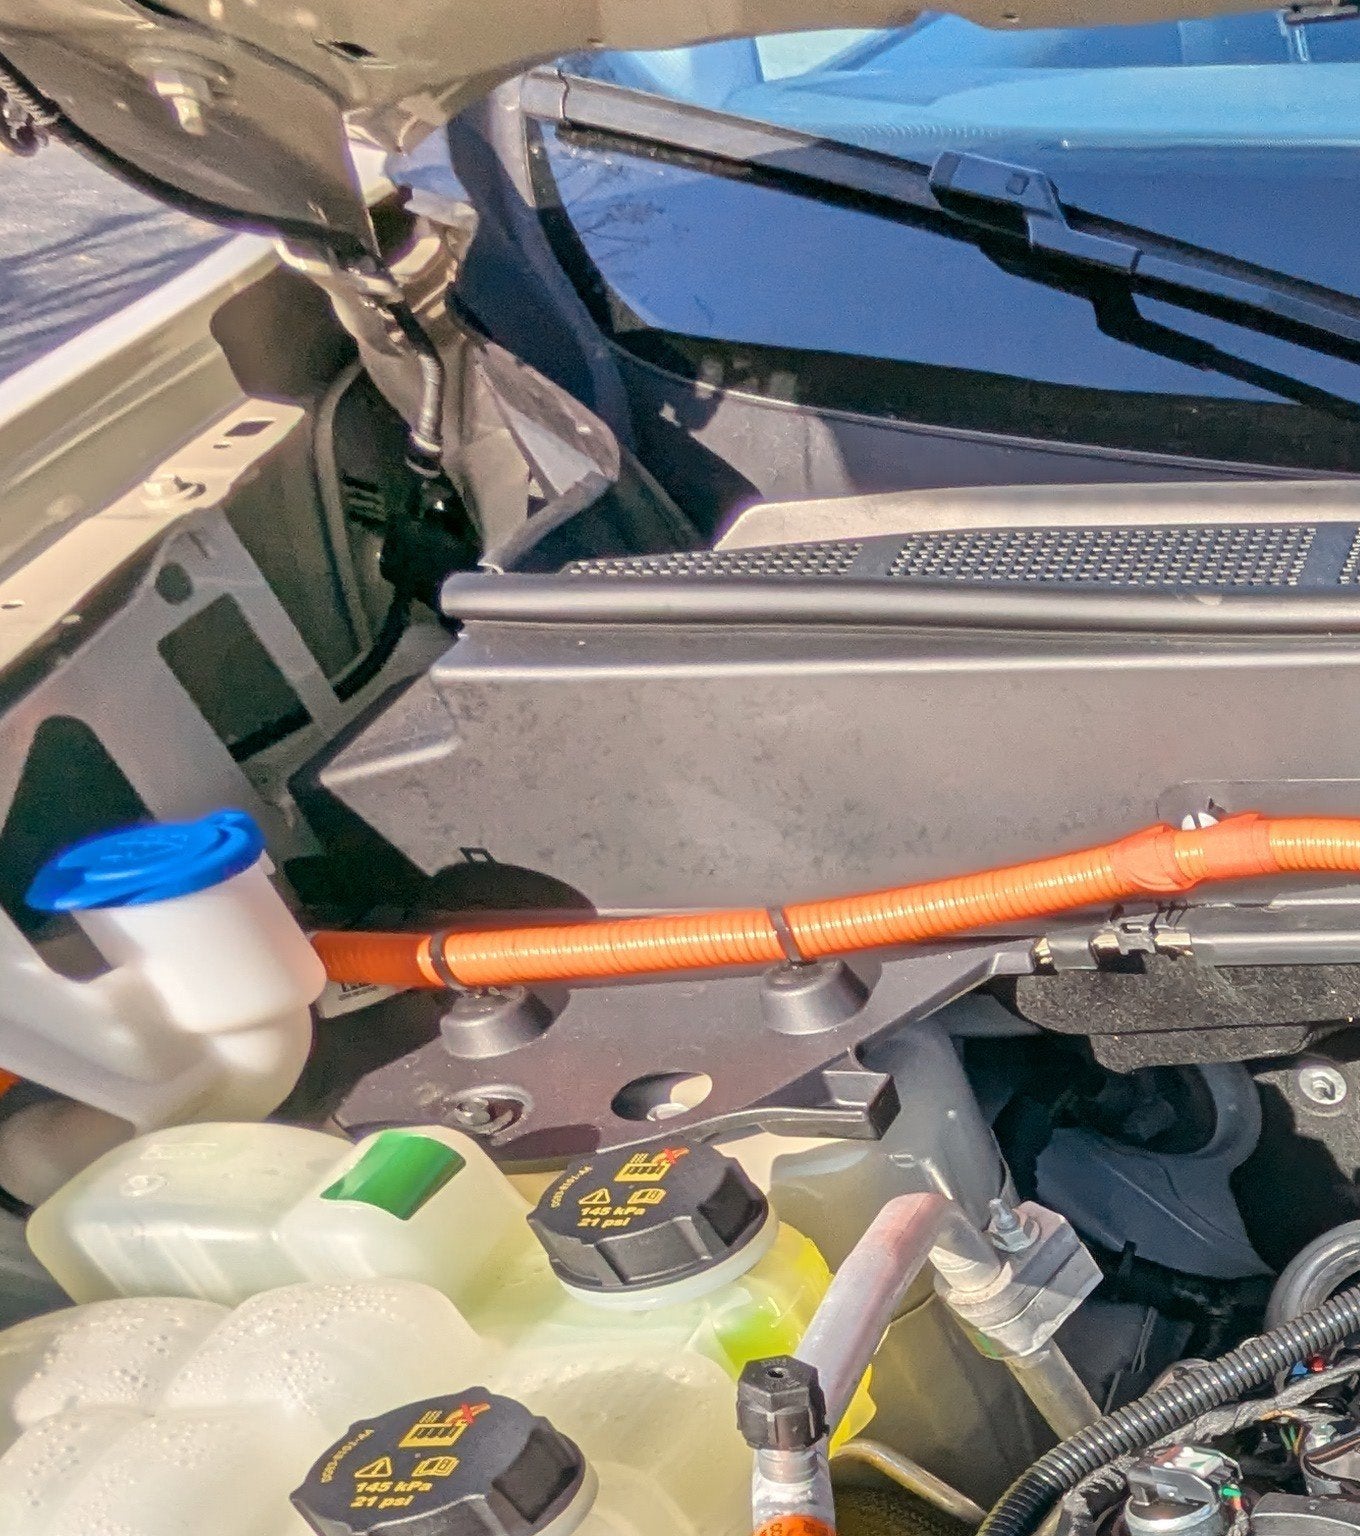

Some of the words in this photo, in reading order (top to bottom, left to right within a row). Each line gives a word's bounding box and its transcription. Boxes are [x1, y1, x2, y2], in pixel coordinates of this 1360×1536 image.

[579, 1206, 608, 1216] 145
[612, 1206, 646, 1216] kPa
[577, 1217, 599, 1227] 21
[601, 1217, 632, 1229] psi
[355, 1481, 391, 1492] 145
[393, 1480, 433, 1492] kPa
[350, 1497, 378, 1508] 21
[378, 1495, 415, 1509] psi
